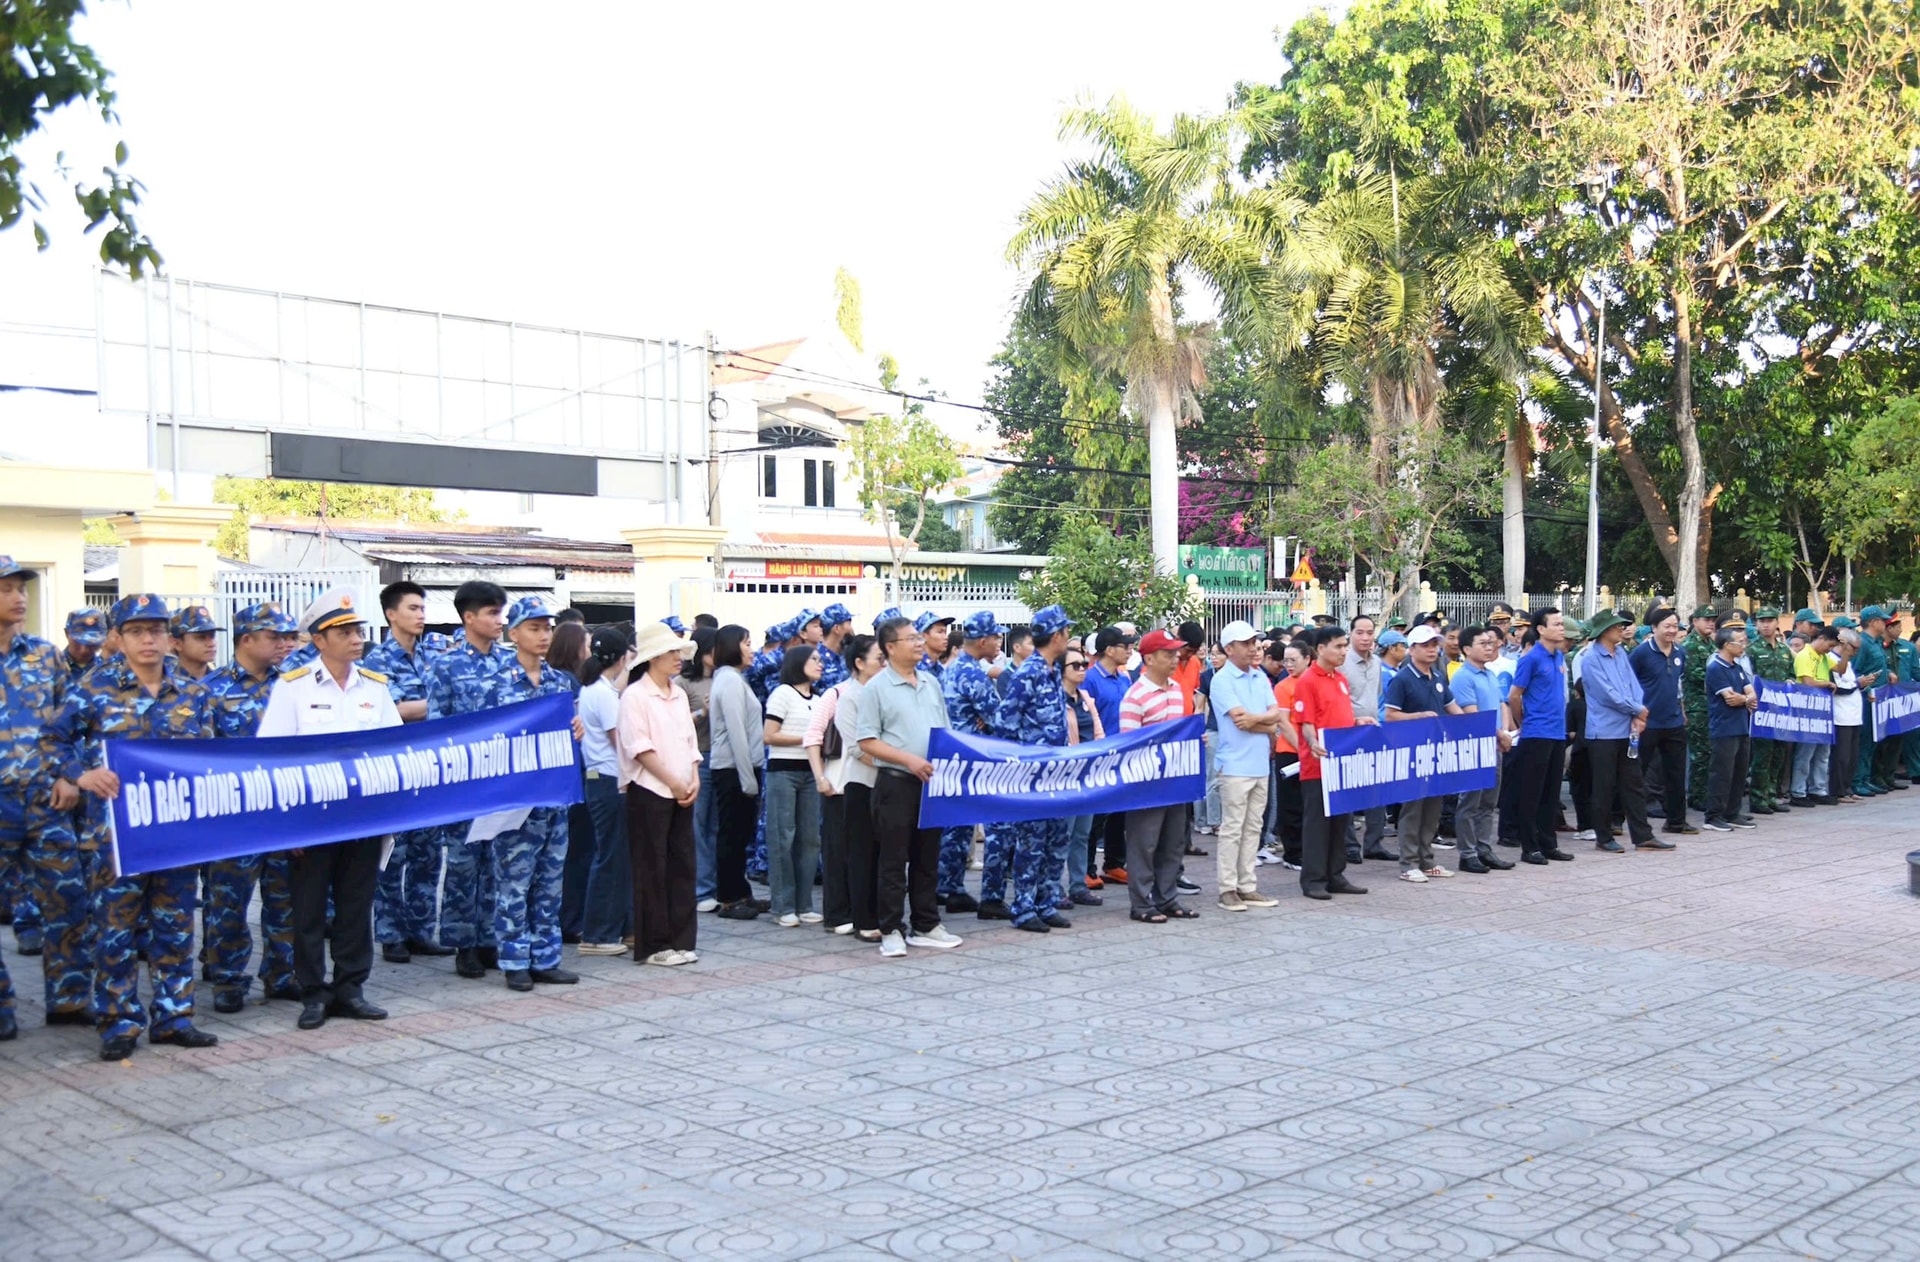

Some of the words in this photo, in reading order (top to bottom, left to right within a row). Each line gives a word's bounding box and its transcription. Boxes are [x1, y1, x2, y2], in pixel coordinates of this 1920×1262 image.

[793, 563, 812, 577] LUẬT
[814, 564, 840, 576] THÀNH
[841, 566, 860, 576] NAM
[1224, 576, 1242, 586] Milk
[1828, 720, 1832, 734] T
[125, 770, 153, 828] BỎ
[154, 772, 192, 824] RÁC
[194, 768, 241, 818] ĐÚNG
[273, 766, 306, 812] QUY
[305, 761, 348, 810] ĐỊNH
[354, 752, 400, 797] HÀNH
[397, 745, 440, 796] ĐỘNG
[439, 738, 469, 784] CỦA
[469, 732, 510, 780] NGƯỜI
[512, 730, 538, 774] VĂN
[538, 729, 574, 770] MINH
[928, 752, 966, 798] MÔI
[968, 756, 1036, 796] TRƯỜNG
[1035, 758, 1088, 798] SẠCH,
[1084, 749, 1118, 788] SỨC
[1162, 738, 1200, 778] XANH
[1340, 748, 1374, 790] TRƯỜNG
[1436, 731, 1458, 774] SỐNG
[1458, 734, 1478, 771] NGÀY
